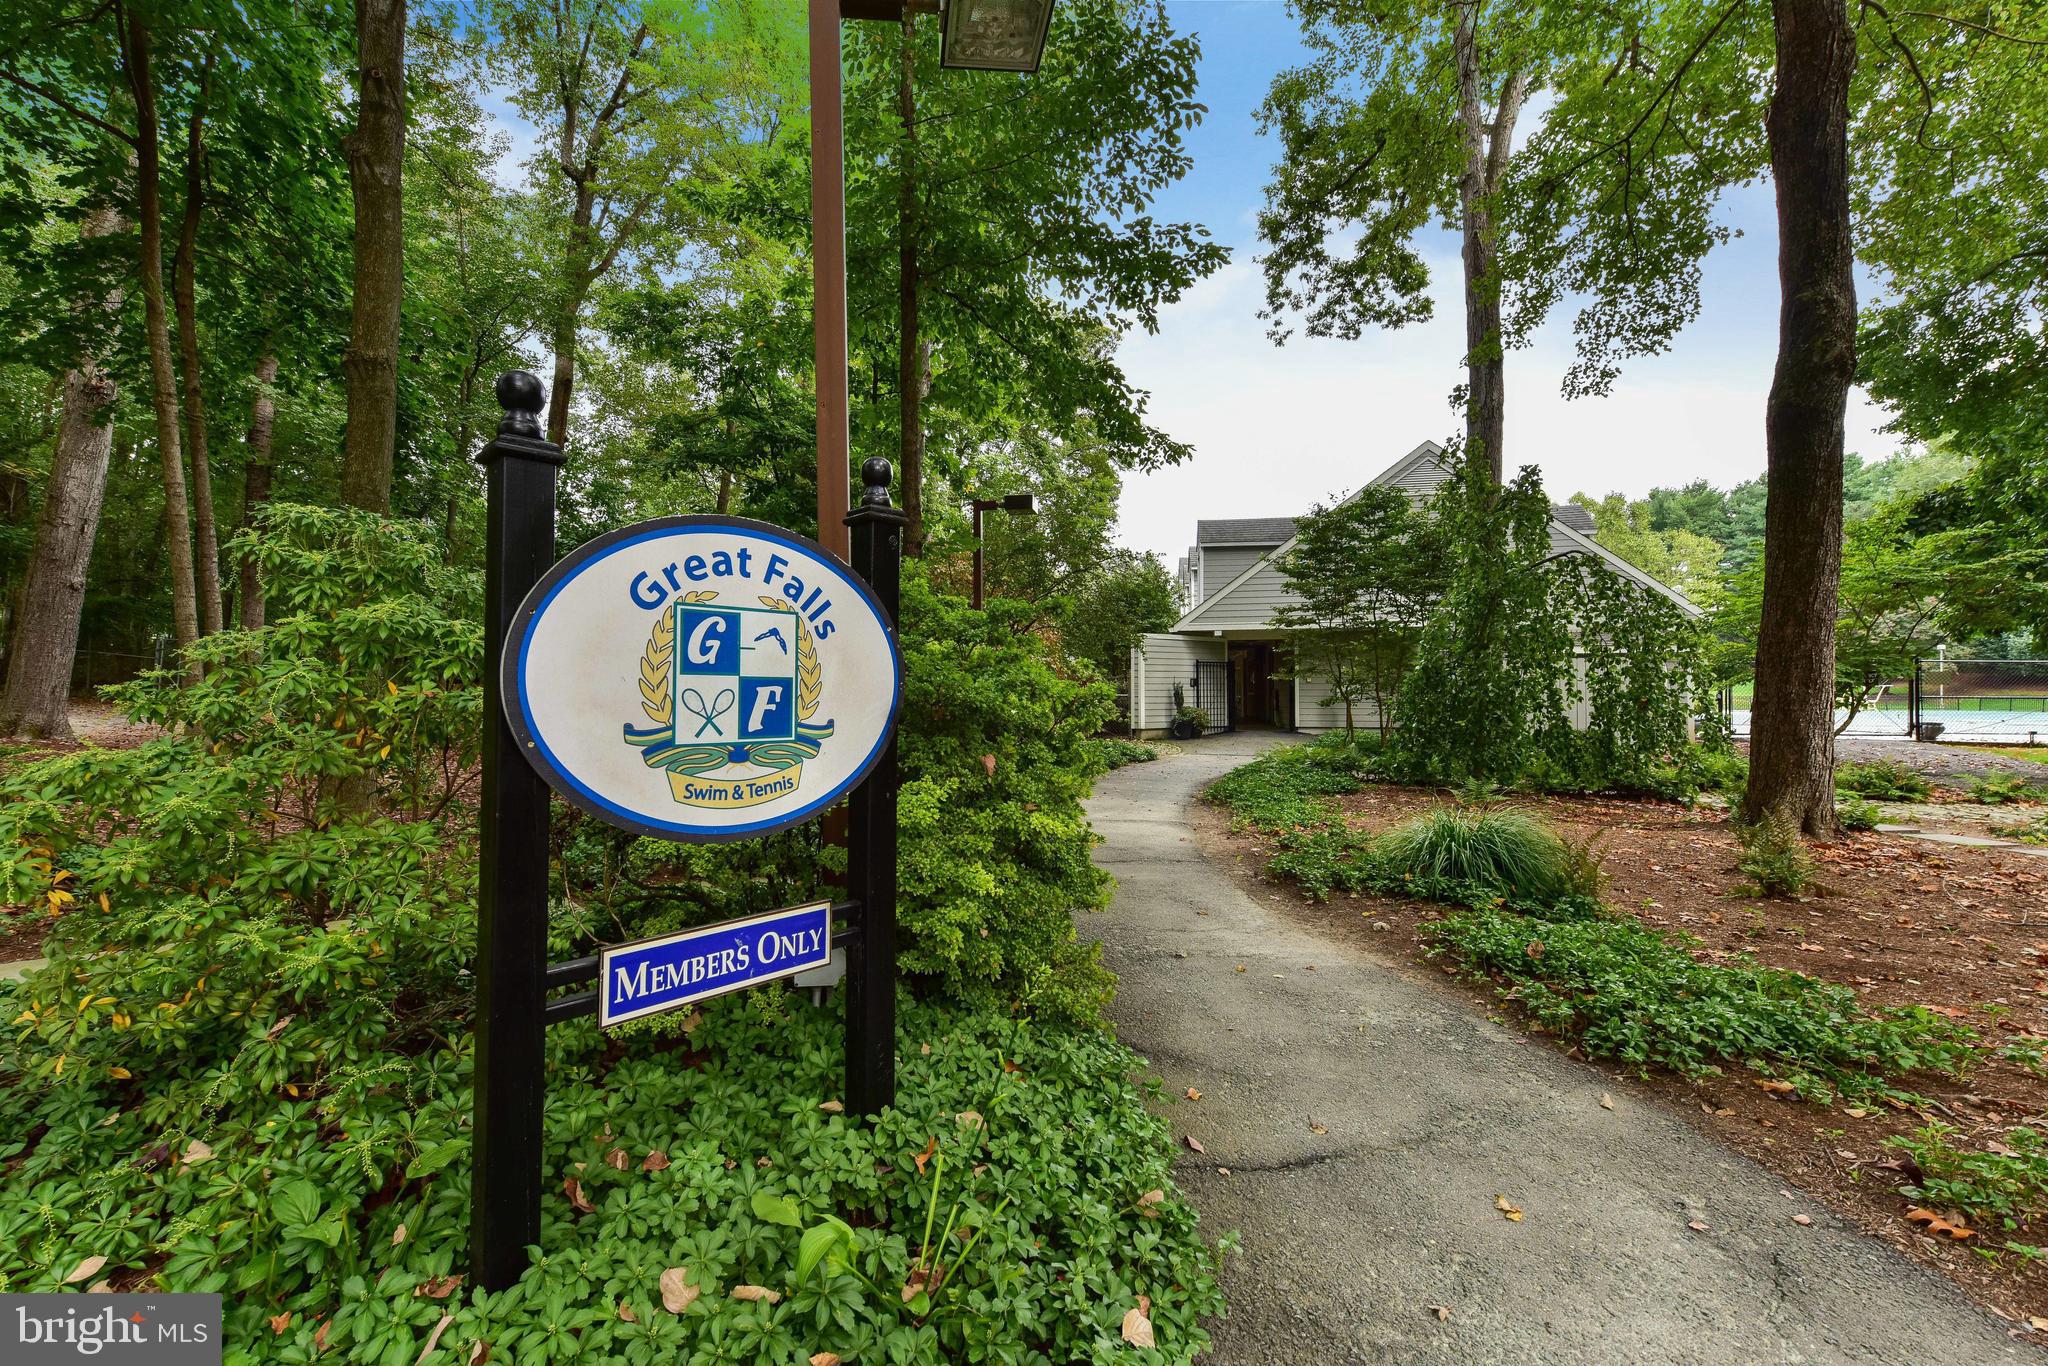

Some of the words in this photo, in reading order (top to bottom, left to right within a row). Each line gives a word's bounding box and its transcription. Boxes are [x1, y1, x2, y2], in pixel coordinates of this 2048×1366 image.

[629, 547, 752, 611] Great
[762, 552, 836, 641] Falls
[687, 616, 727, 665] G
[747, 685, 783, 732] F
[683, 782, 729, 802] Swim
[732, 785, 744, 800] &
[746, 776, 794, 798] Tennis
[614, 944, 750, 1004] MEMBERS
[757, 927, 823, 965] ONLY
